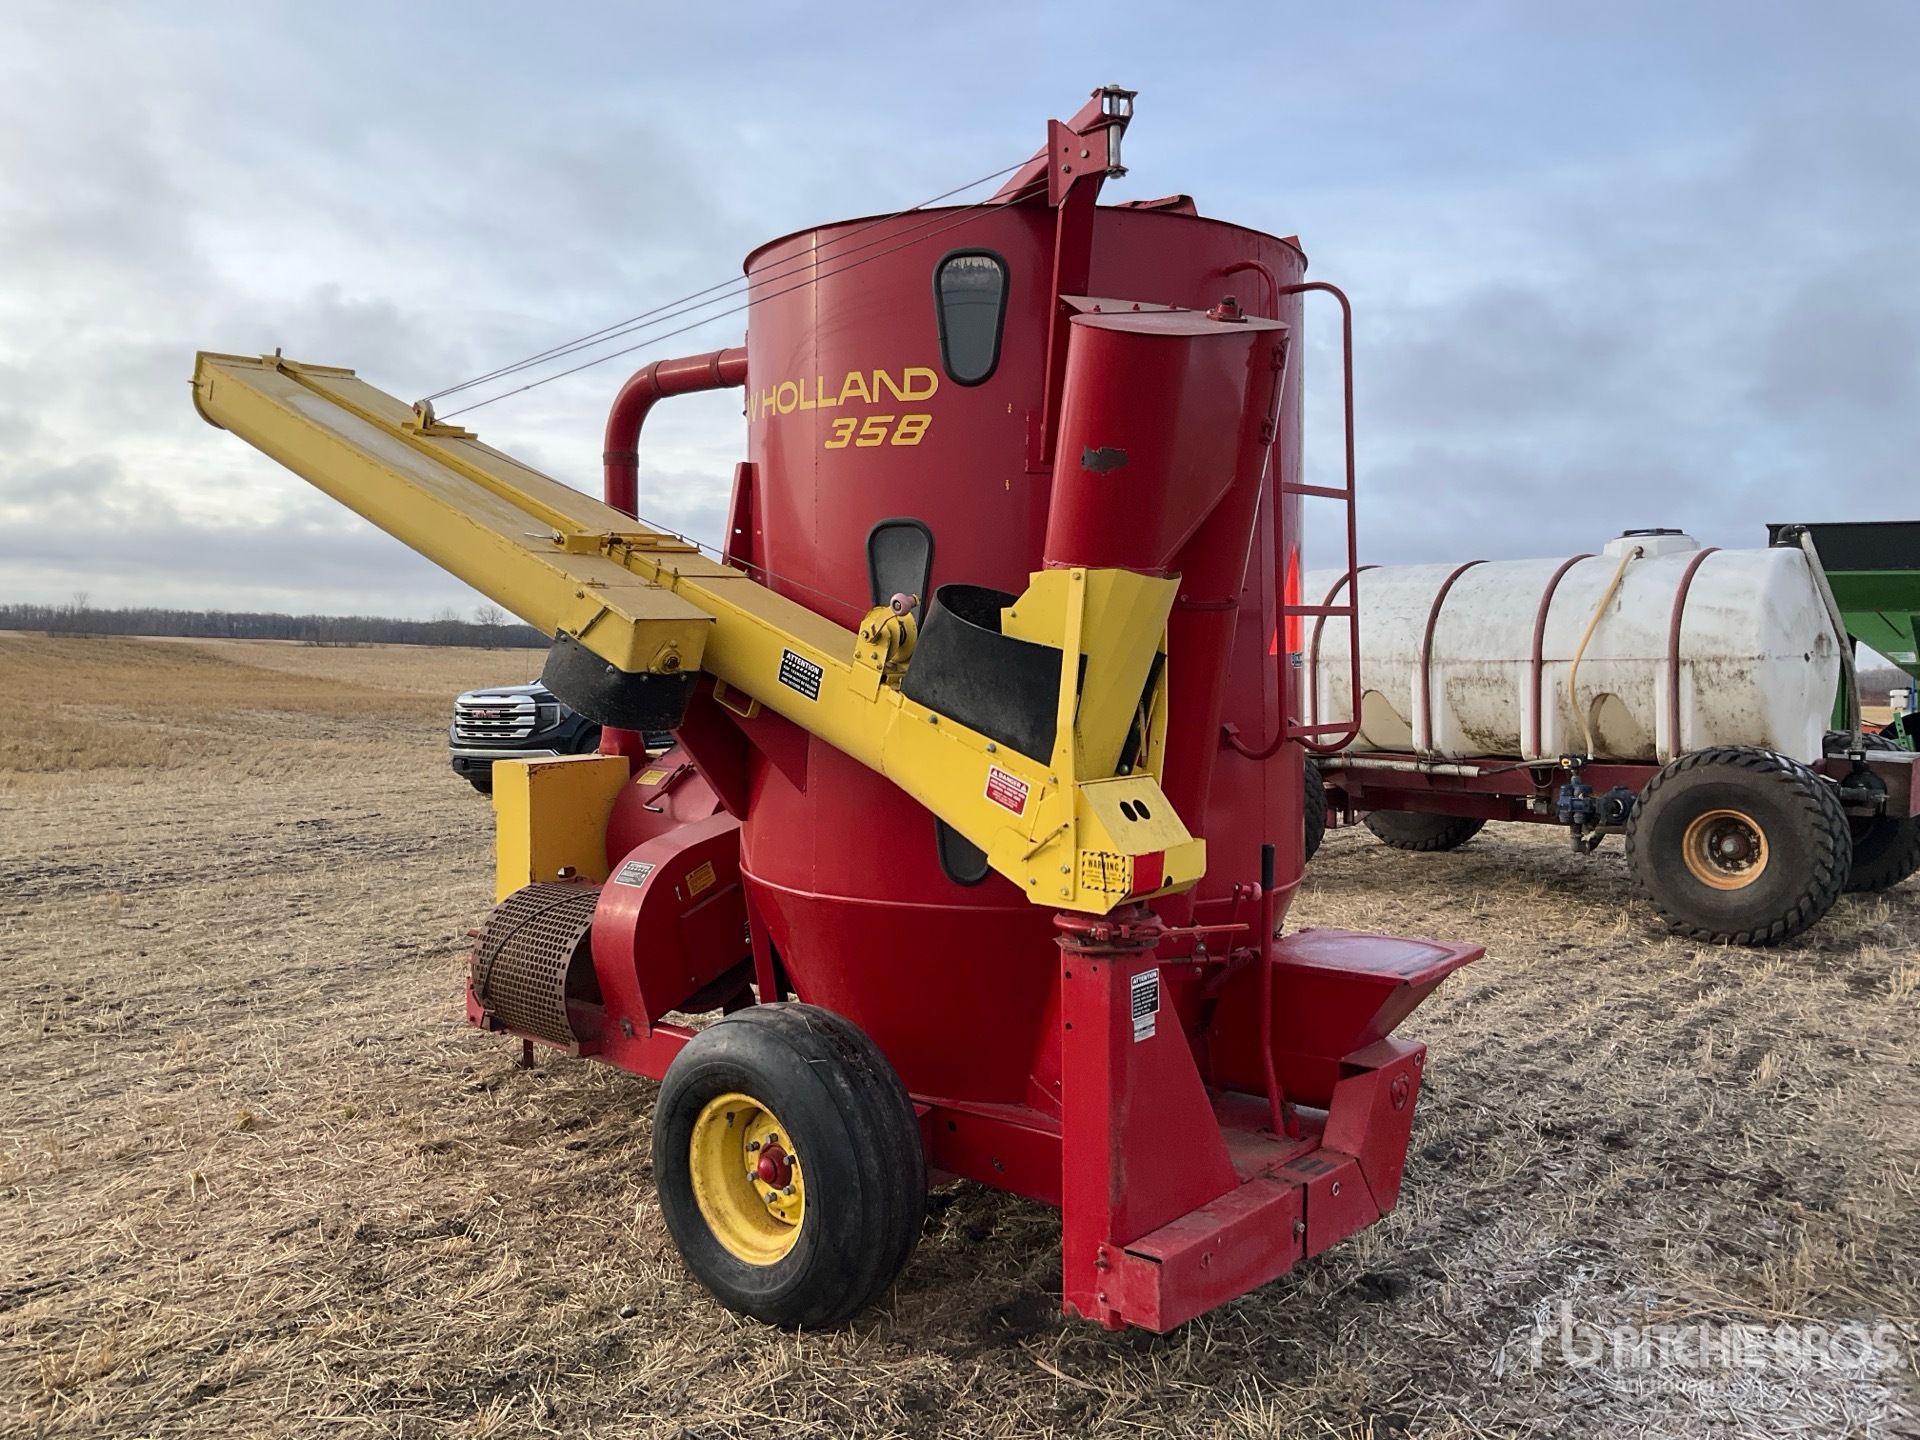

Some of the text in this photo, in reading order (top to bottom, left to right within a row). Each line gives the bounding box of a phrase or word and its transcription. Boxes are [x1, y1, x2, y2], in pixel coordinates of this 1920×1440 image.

[762, 367, 939, 419] HOLLAND
[824, 414, 932, 449] 358
[786, 652, 820, 675] ATTENTION
[471, 709, 495, 719] GMC
[1088, 859, 1119, 872] WARING
